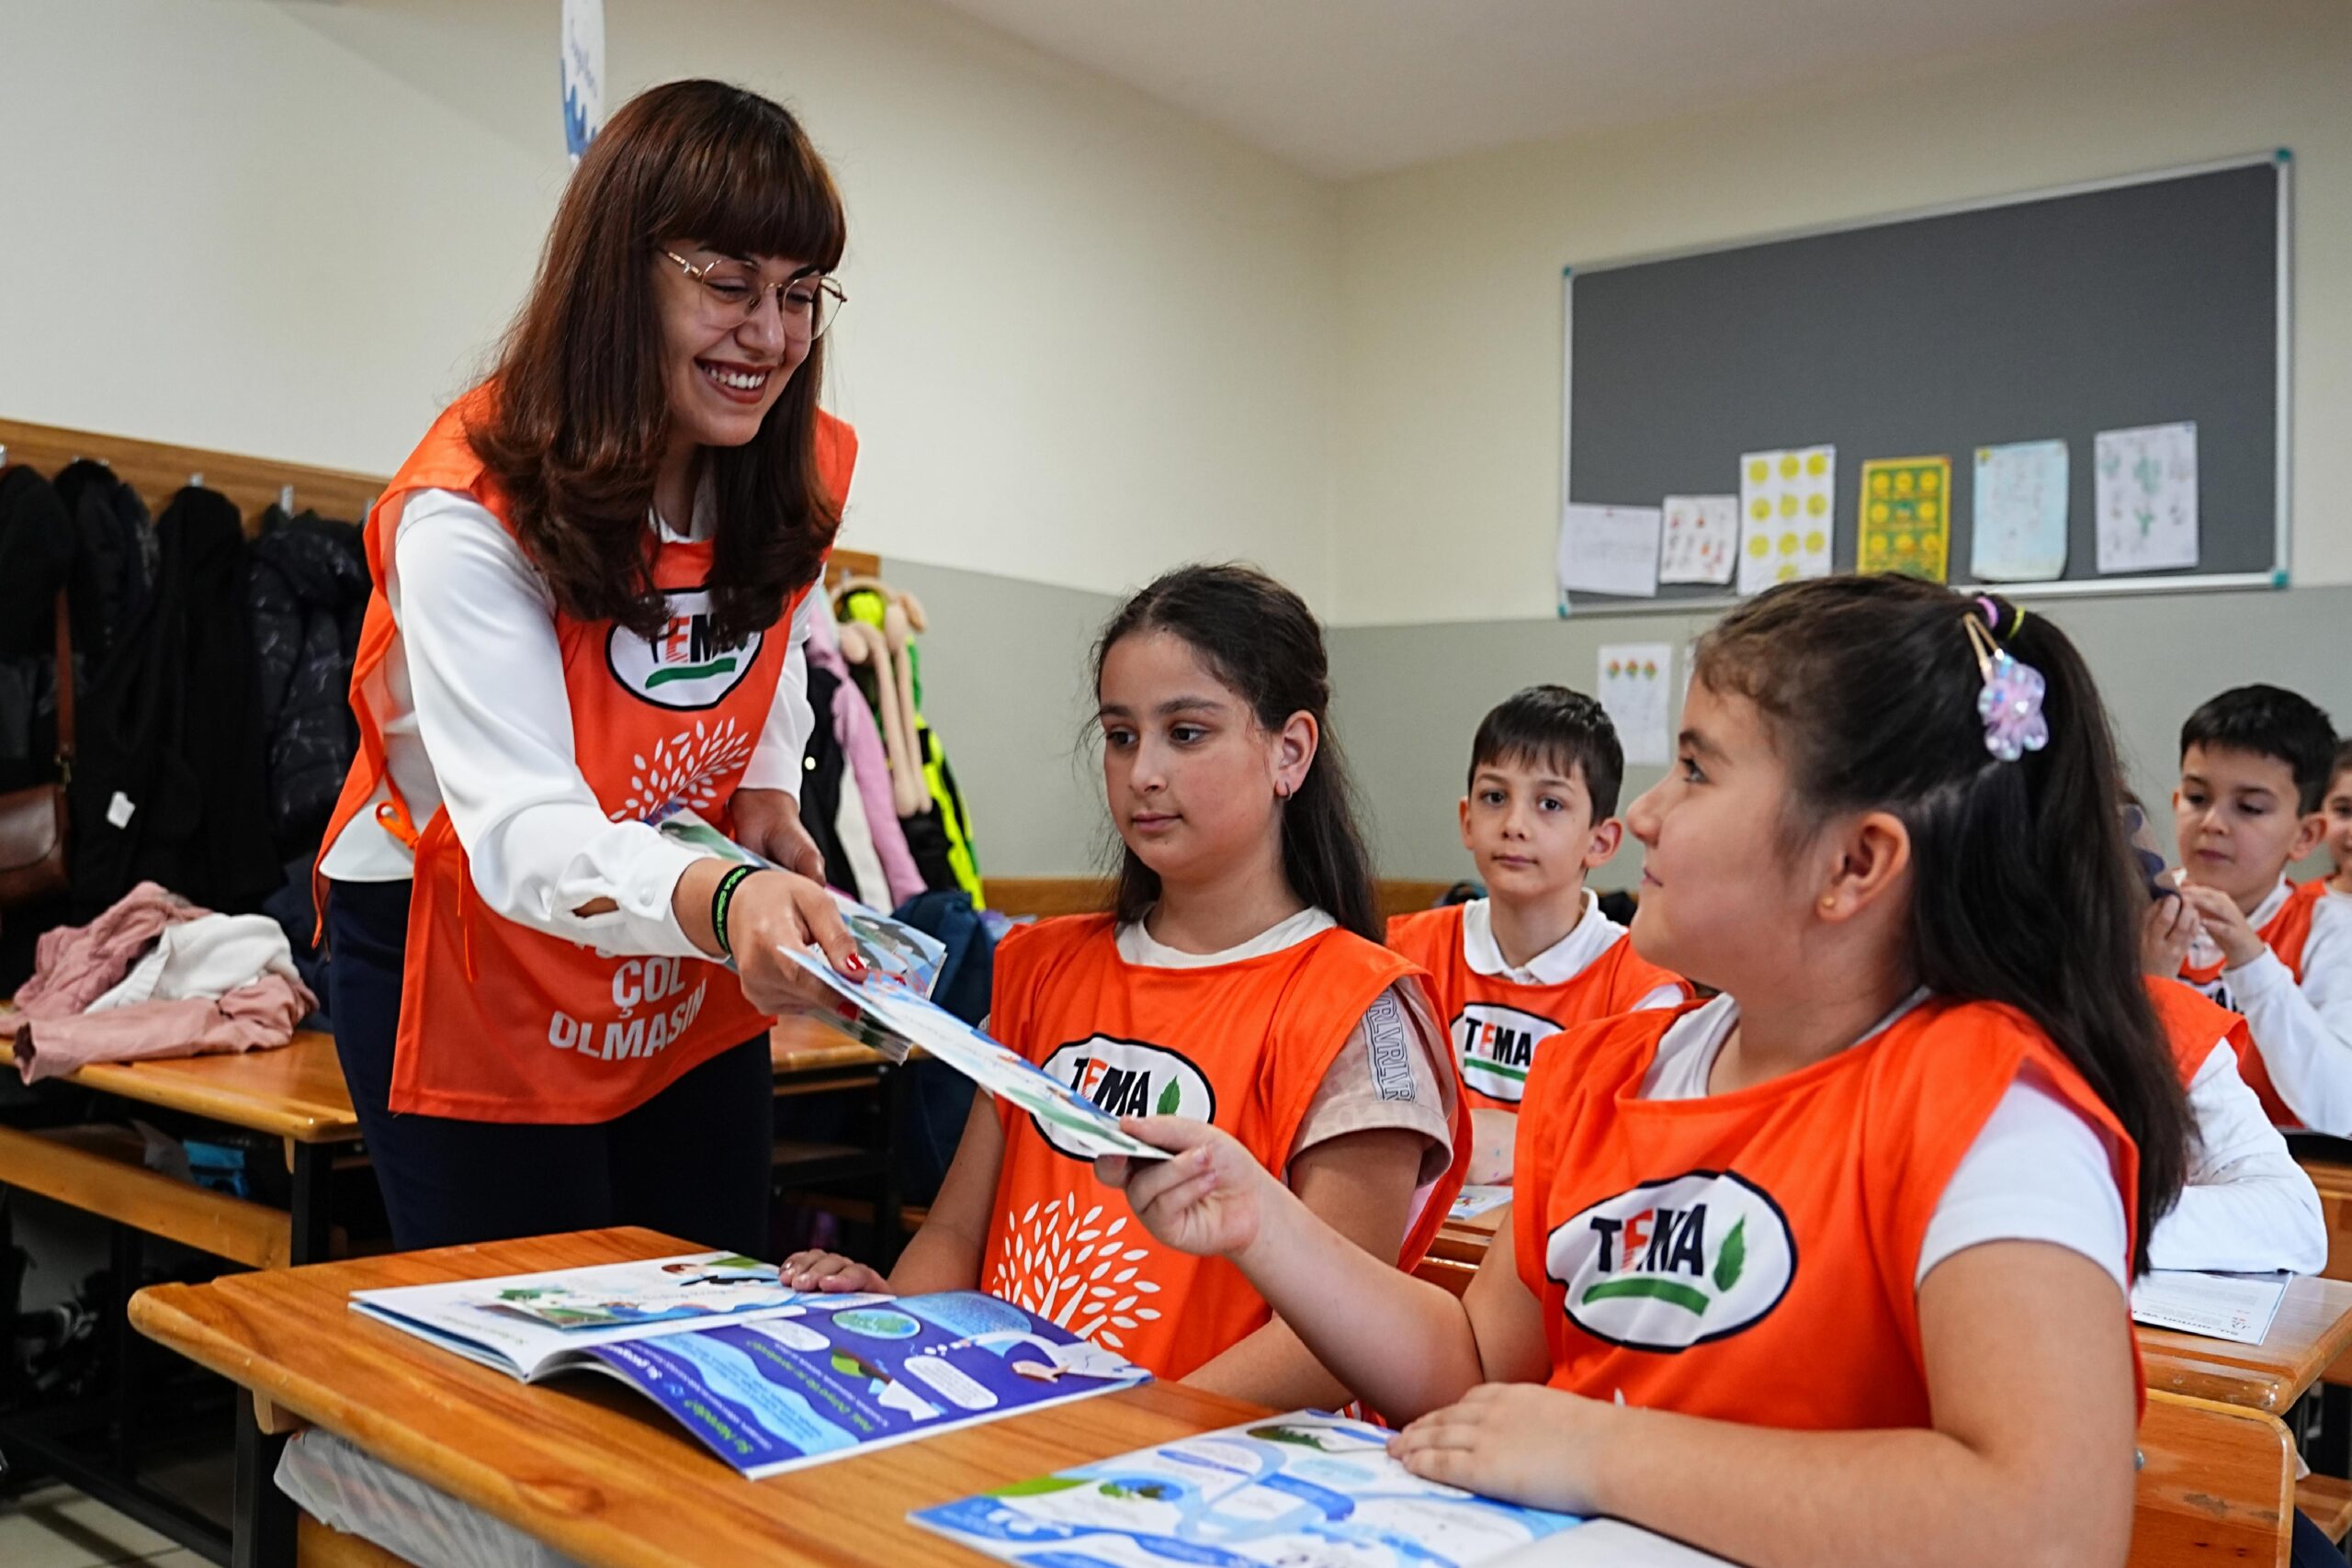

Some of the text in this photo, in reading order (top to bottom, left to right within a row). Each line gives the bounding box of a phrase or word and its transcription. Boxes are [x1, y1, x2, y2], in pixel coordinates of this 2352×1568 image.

[548, 977, 707, 1061] OLMASIN
[1464, 1017, 1532, 1067] TEMA
[1070, 1056, 1151, 1118] TEMA
